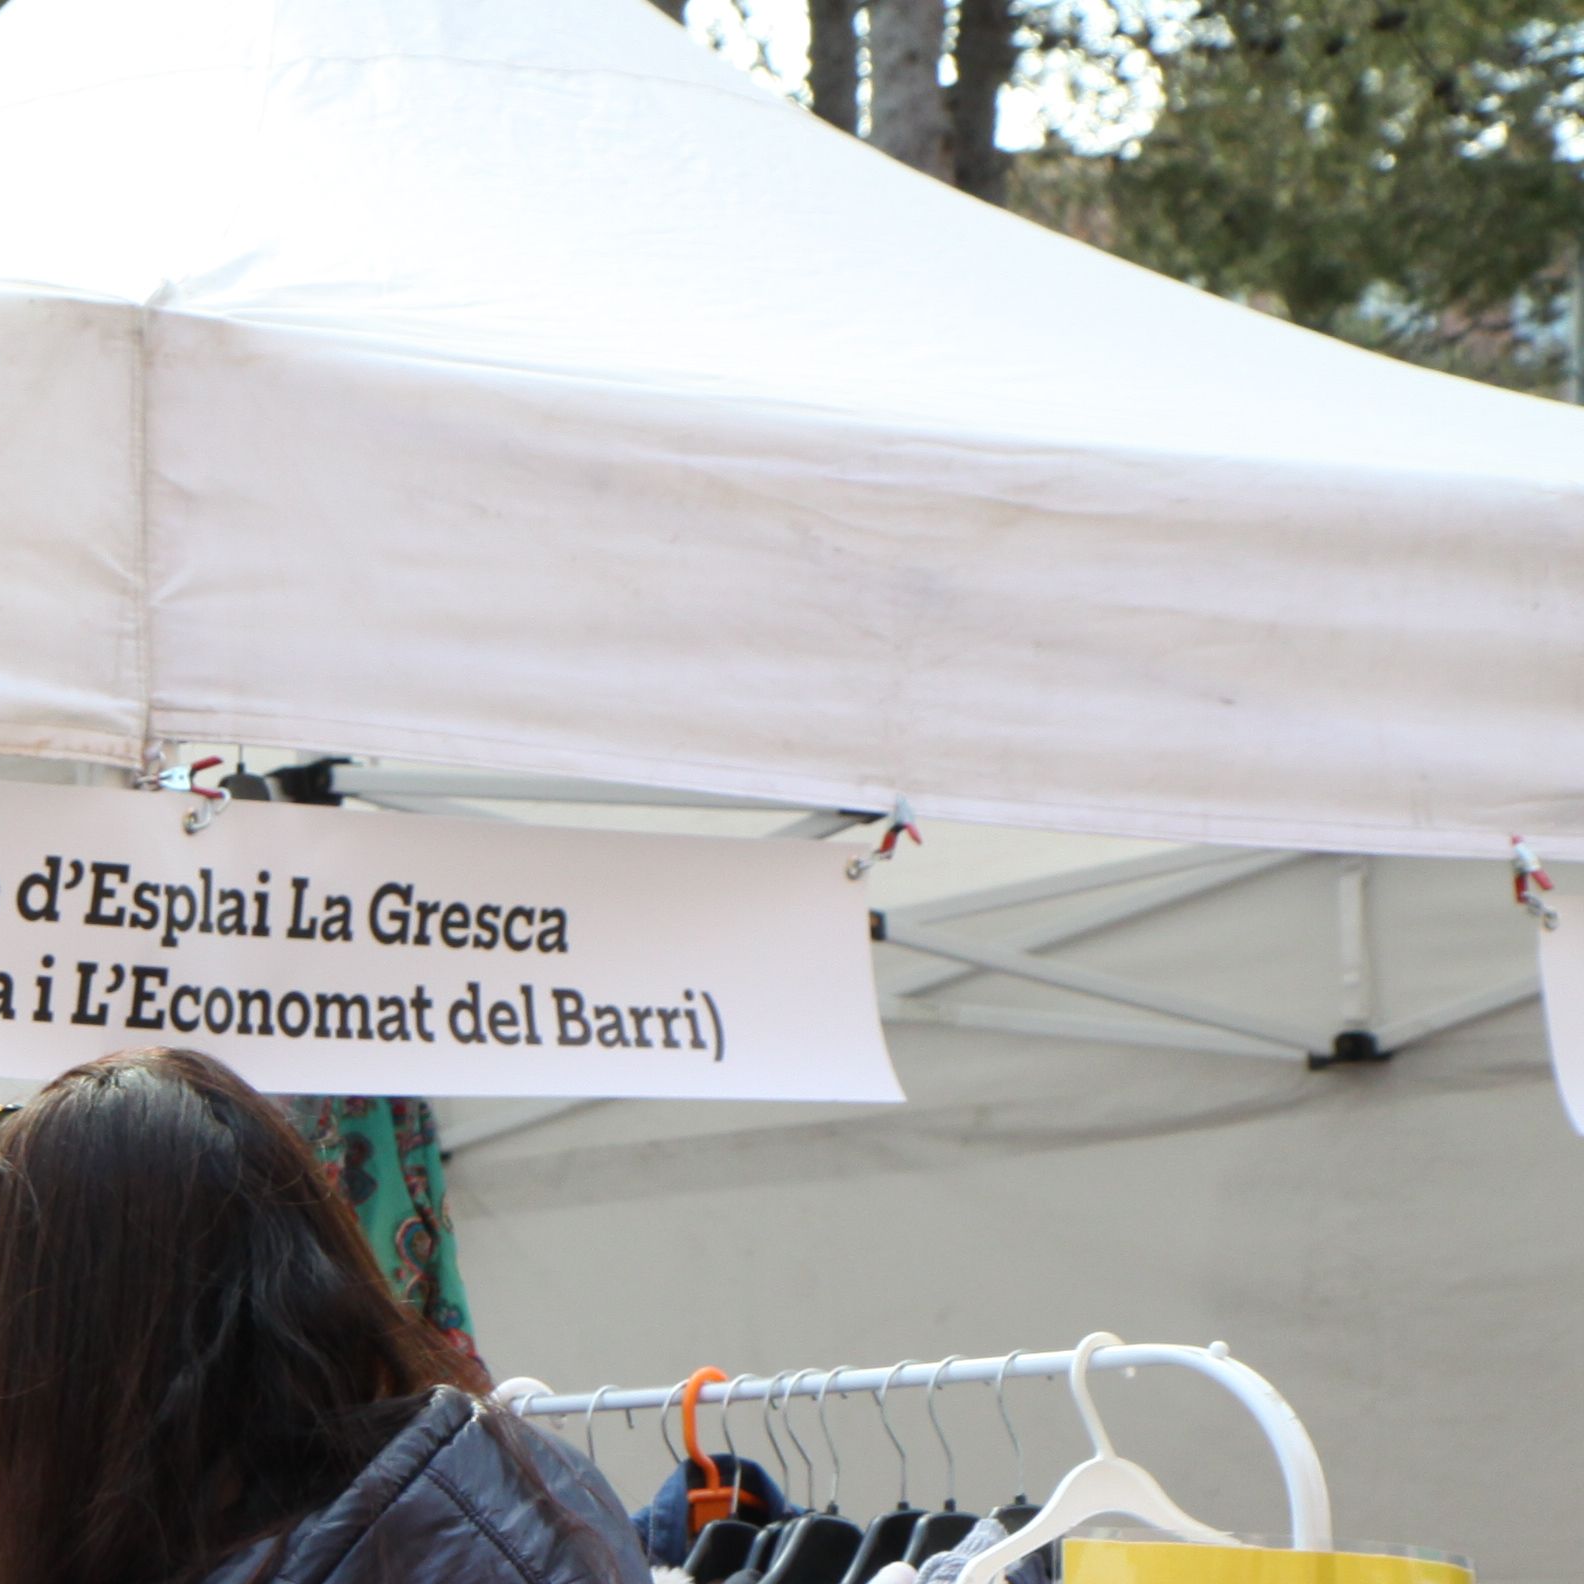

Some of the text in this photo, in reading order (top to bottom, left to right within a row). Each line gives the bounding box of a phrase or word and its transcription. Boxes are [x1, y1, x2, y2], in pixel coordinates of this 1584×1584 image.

[16, 856, 271, 947] d'Esplai
[286, 878, 353, 942] La
[369, 882, 568, 953] Gresca
[32, 955, 54, 1023] i
[71, 962, 434, 1042] L'Economat
[448, 982, 542, 1045] del
[551, 988, 724, 1062] Barri)
